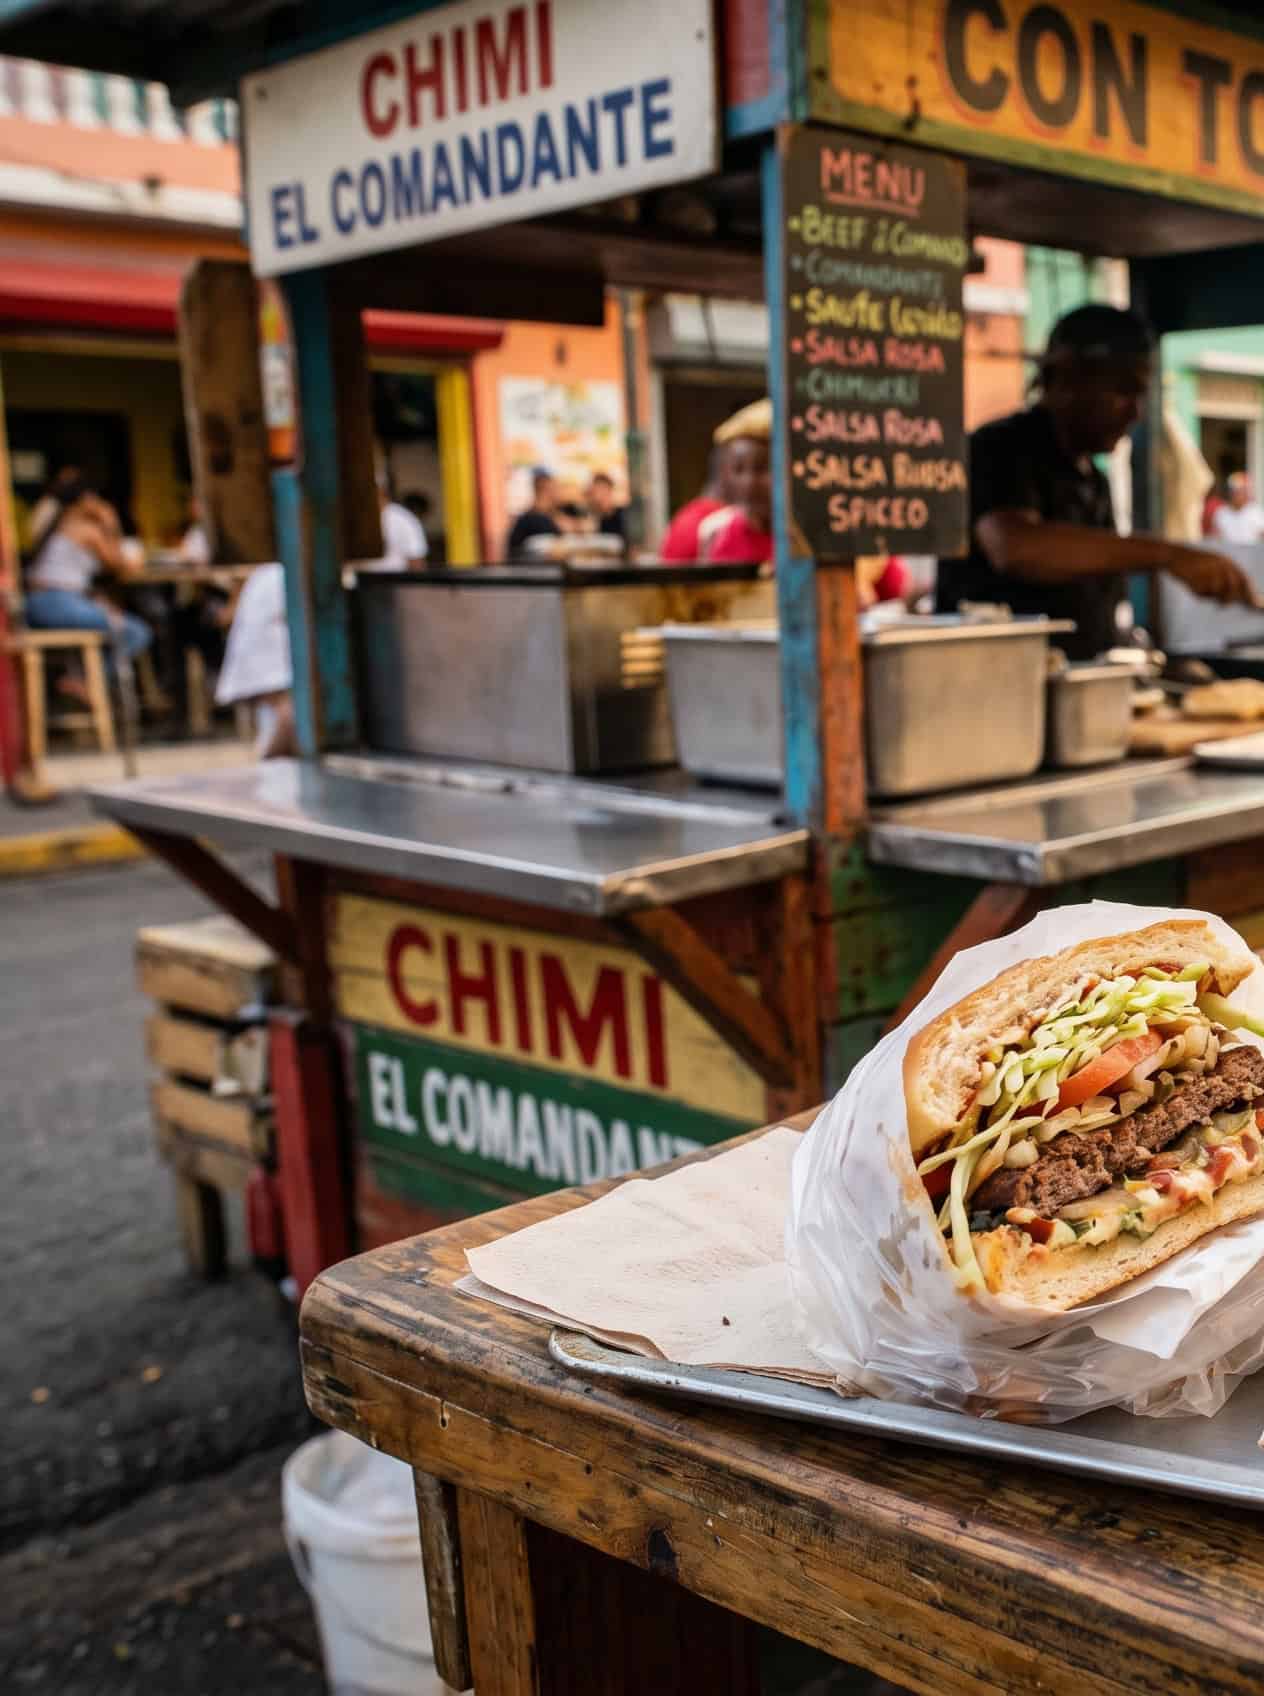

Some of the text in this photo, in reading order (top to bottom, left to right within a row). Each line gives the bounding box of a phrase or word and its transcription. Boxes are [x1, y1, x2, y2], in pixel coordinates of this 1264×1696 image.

[360, 0, 555, 139] CHIMI
[942, 0, 1150, 150] CON
[271, 78, 675, 249] EL COMANDANTE
[820, 147, 925, 206] MENU
[806, 328, 879, 367] SALSA
[806, 404, 880, 443] SALSA
[806, 450, 888, 490] SALSA
[385, 921, 669, 1091] CHIMI
[368, 1051, 706, 1186] EL COMANDA
